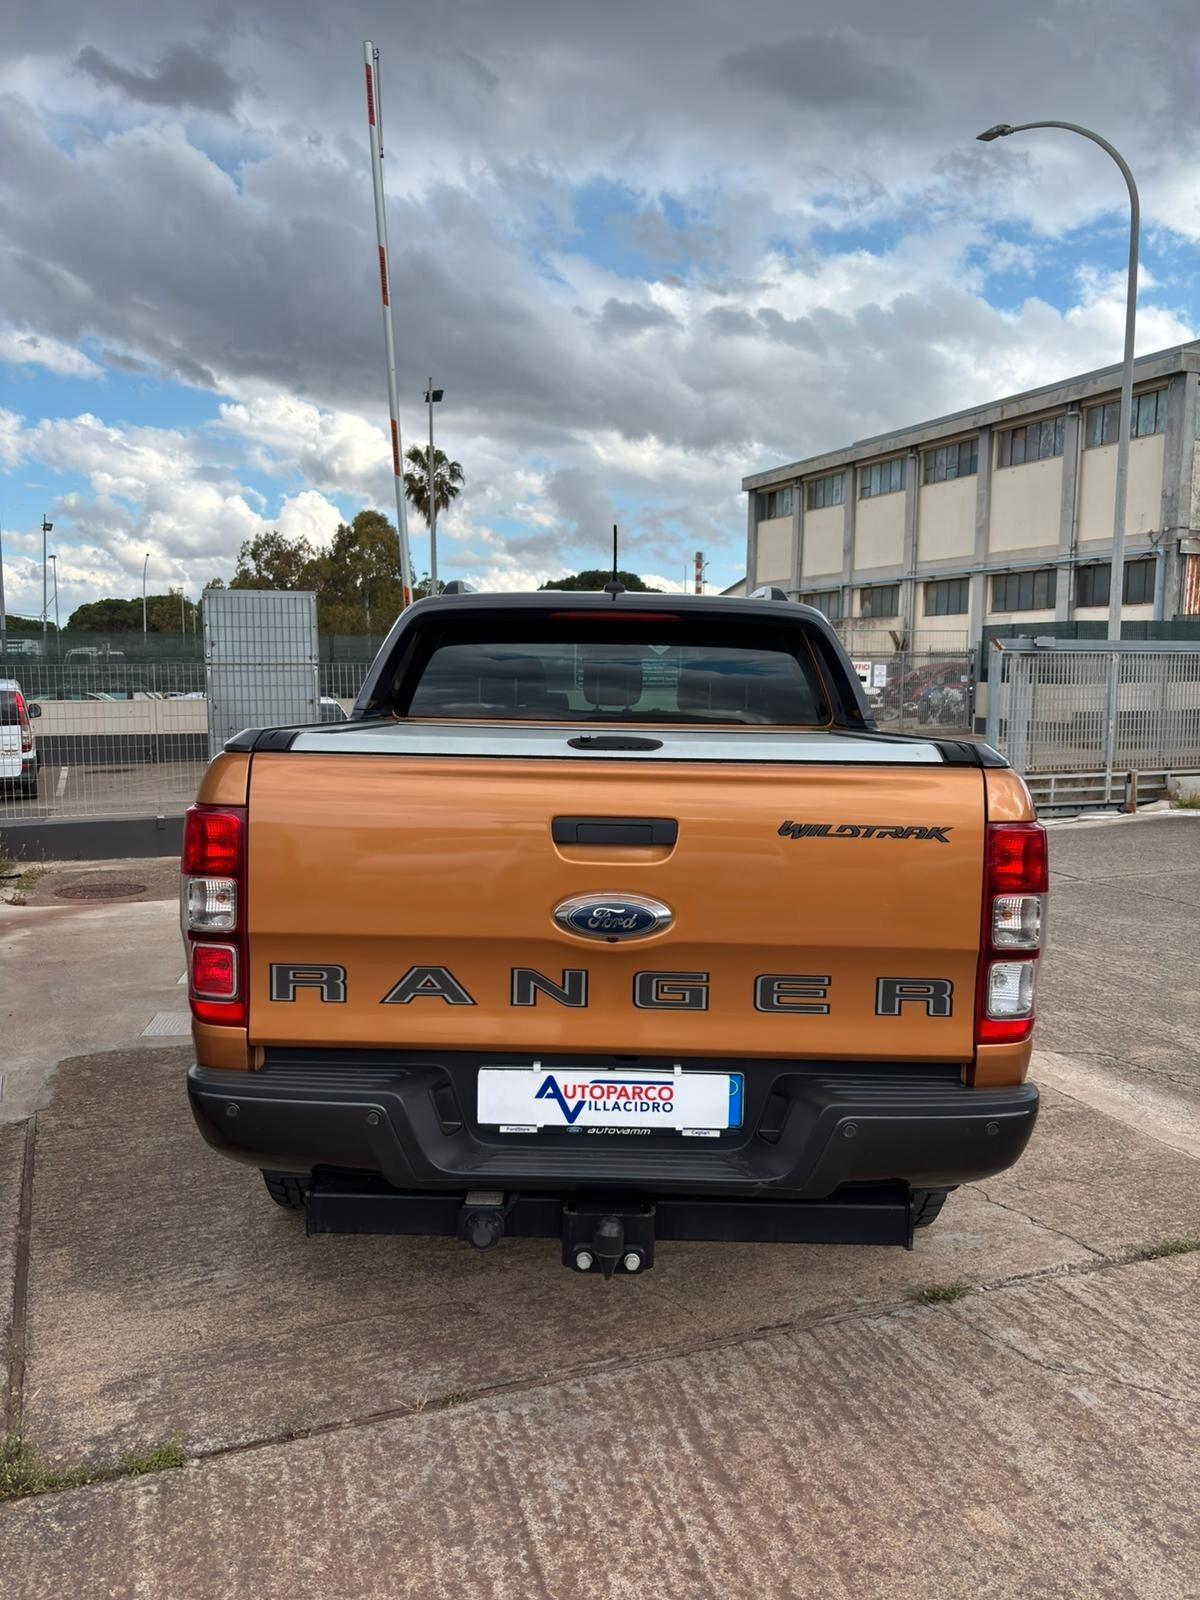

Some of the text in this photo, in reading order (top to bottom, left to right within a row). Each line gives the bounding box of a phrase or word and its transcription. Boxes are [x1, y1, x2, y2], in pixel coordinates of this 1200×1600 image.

[777, 820, 955, 843] WILDTRAK
[588, 907, 638, 929] Ford
[269, 963, 953, 1017] RANGER
[534, 1074, 674, 1101] AUTOPARCO
[557, 1098, 674, 1124] VILLACIDRO
[587, 1127, 651, 1135] autovamm
